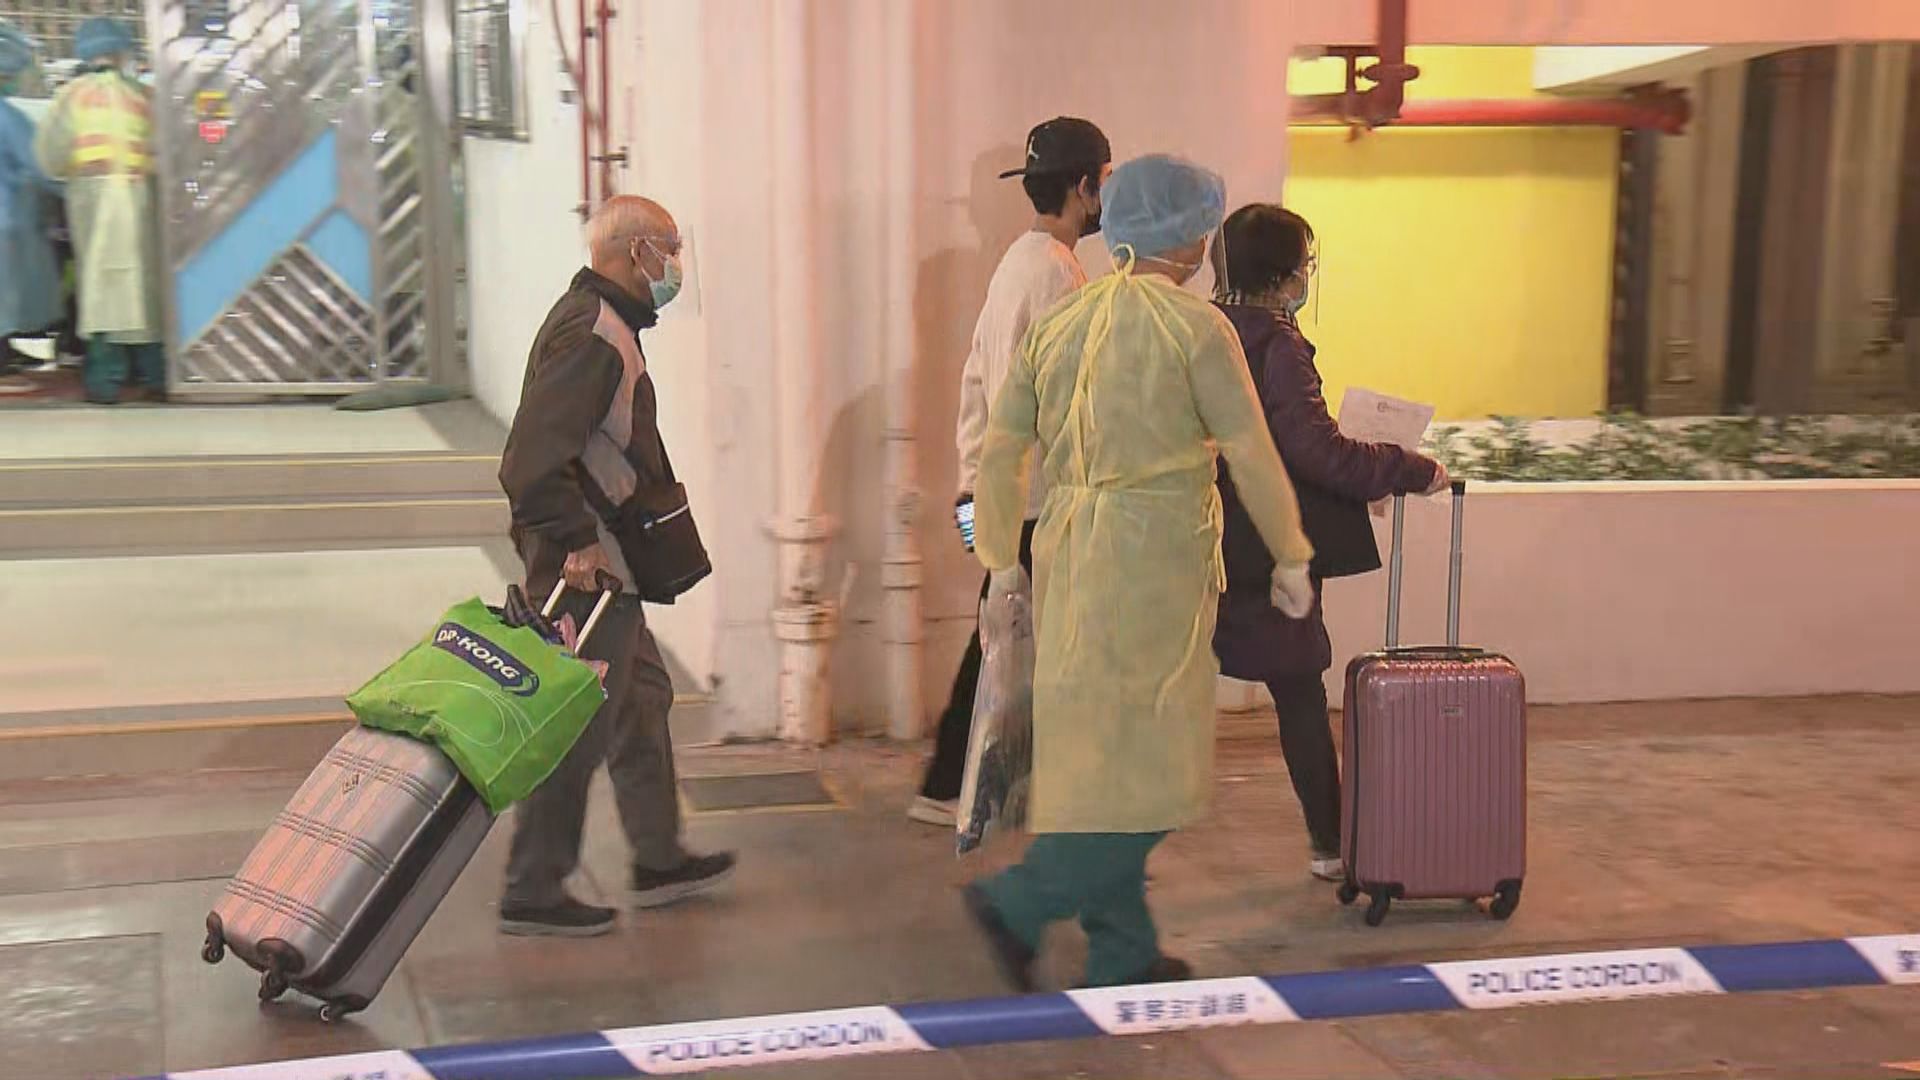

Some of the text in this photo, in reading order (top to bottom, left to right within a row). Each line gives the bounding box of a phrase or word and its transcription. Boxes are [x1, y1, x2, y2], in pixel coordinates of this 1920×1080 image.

[1468, 961, 1681, 993] POLICE CORDON
[650, 1022, 886, 1062] POLICE CORDON
